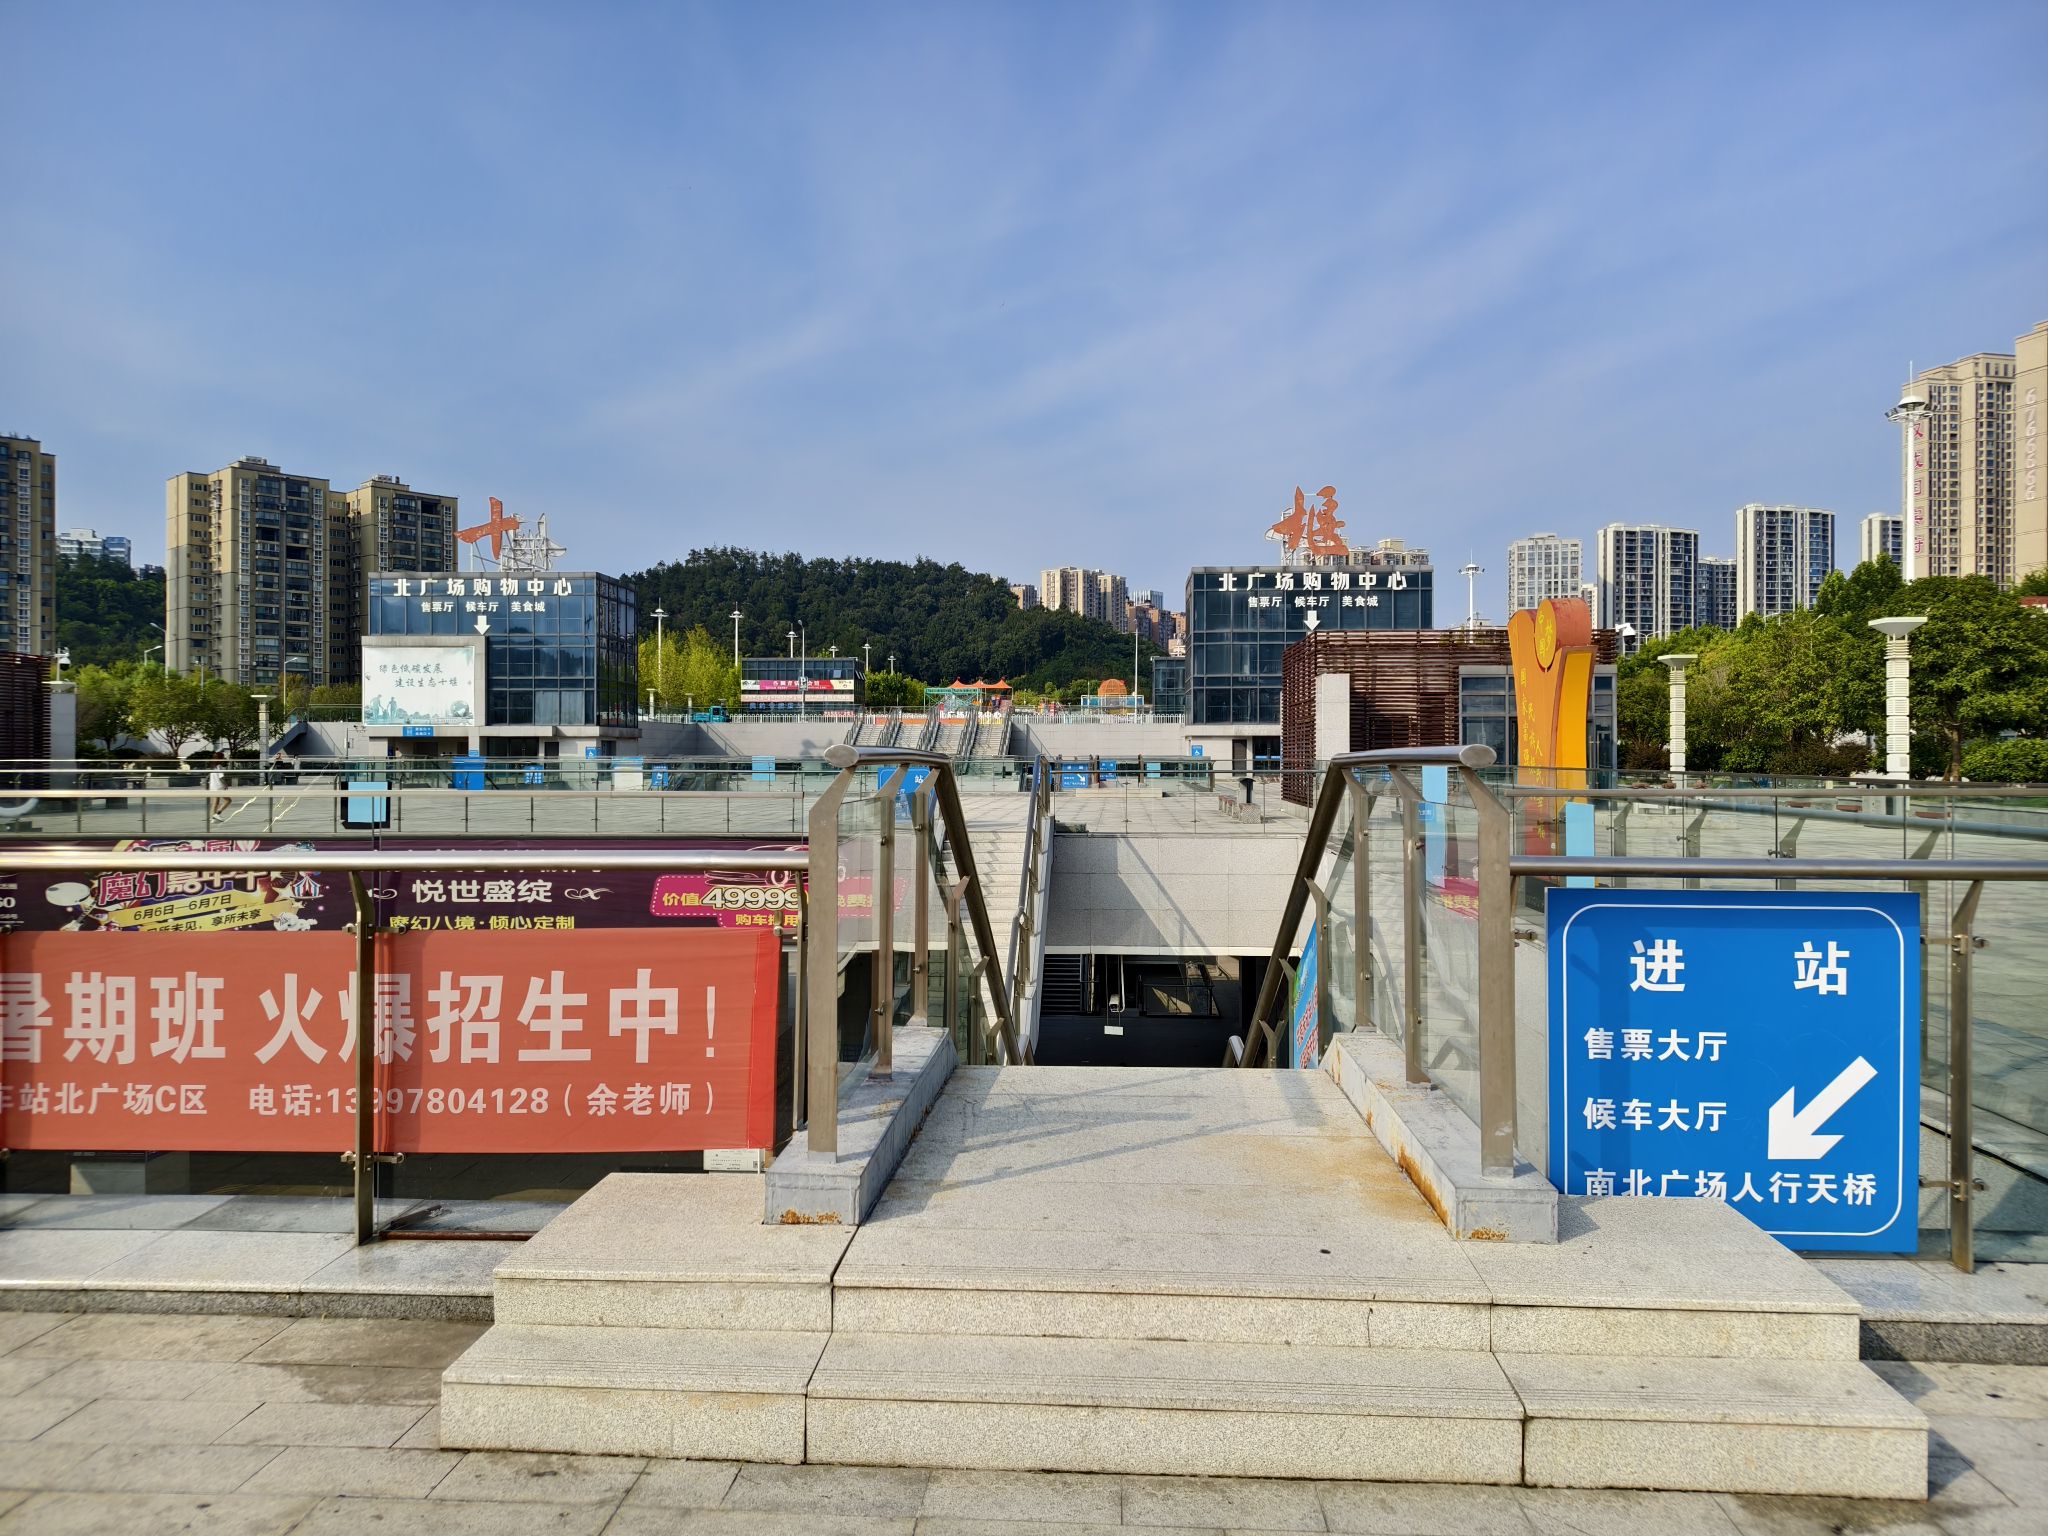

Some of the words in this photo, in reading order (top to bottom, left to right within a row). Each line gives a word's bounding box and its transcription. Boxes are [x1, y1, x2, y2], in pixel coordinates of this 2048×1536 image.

[393, 577, 573, 597] 北广场购物中心
[1218, 570, 1408, 592] 北广场购物中心
[421, 601, 455, 613] 售票厅
[465, 601, 500, 613] 候车厅
[510, 601, 546, 613] 美食城
[1247, 595, 1284, 608] 售票厅
[1294, 595, 1330, 608] 候车厅
[1341, 595, 1379, 608] 美食城
[411, 879, 553, 903] 悦世盛绽
[1629, 939, 1686, 992] 进
[1792, 940, 1851, 996] 站
[0, 972, 225, 1064] 暑期班
[1583, 1027, 1728, 1061] 售票大厅
[1583, 1097, 1728, 1132] 候车大厅
[1583, 1167, 1877, 1206] 南北广场人行天桥
